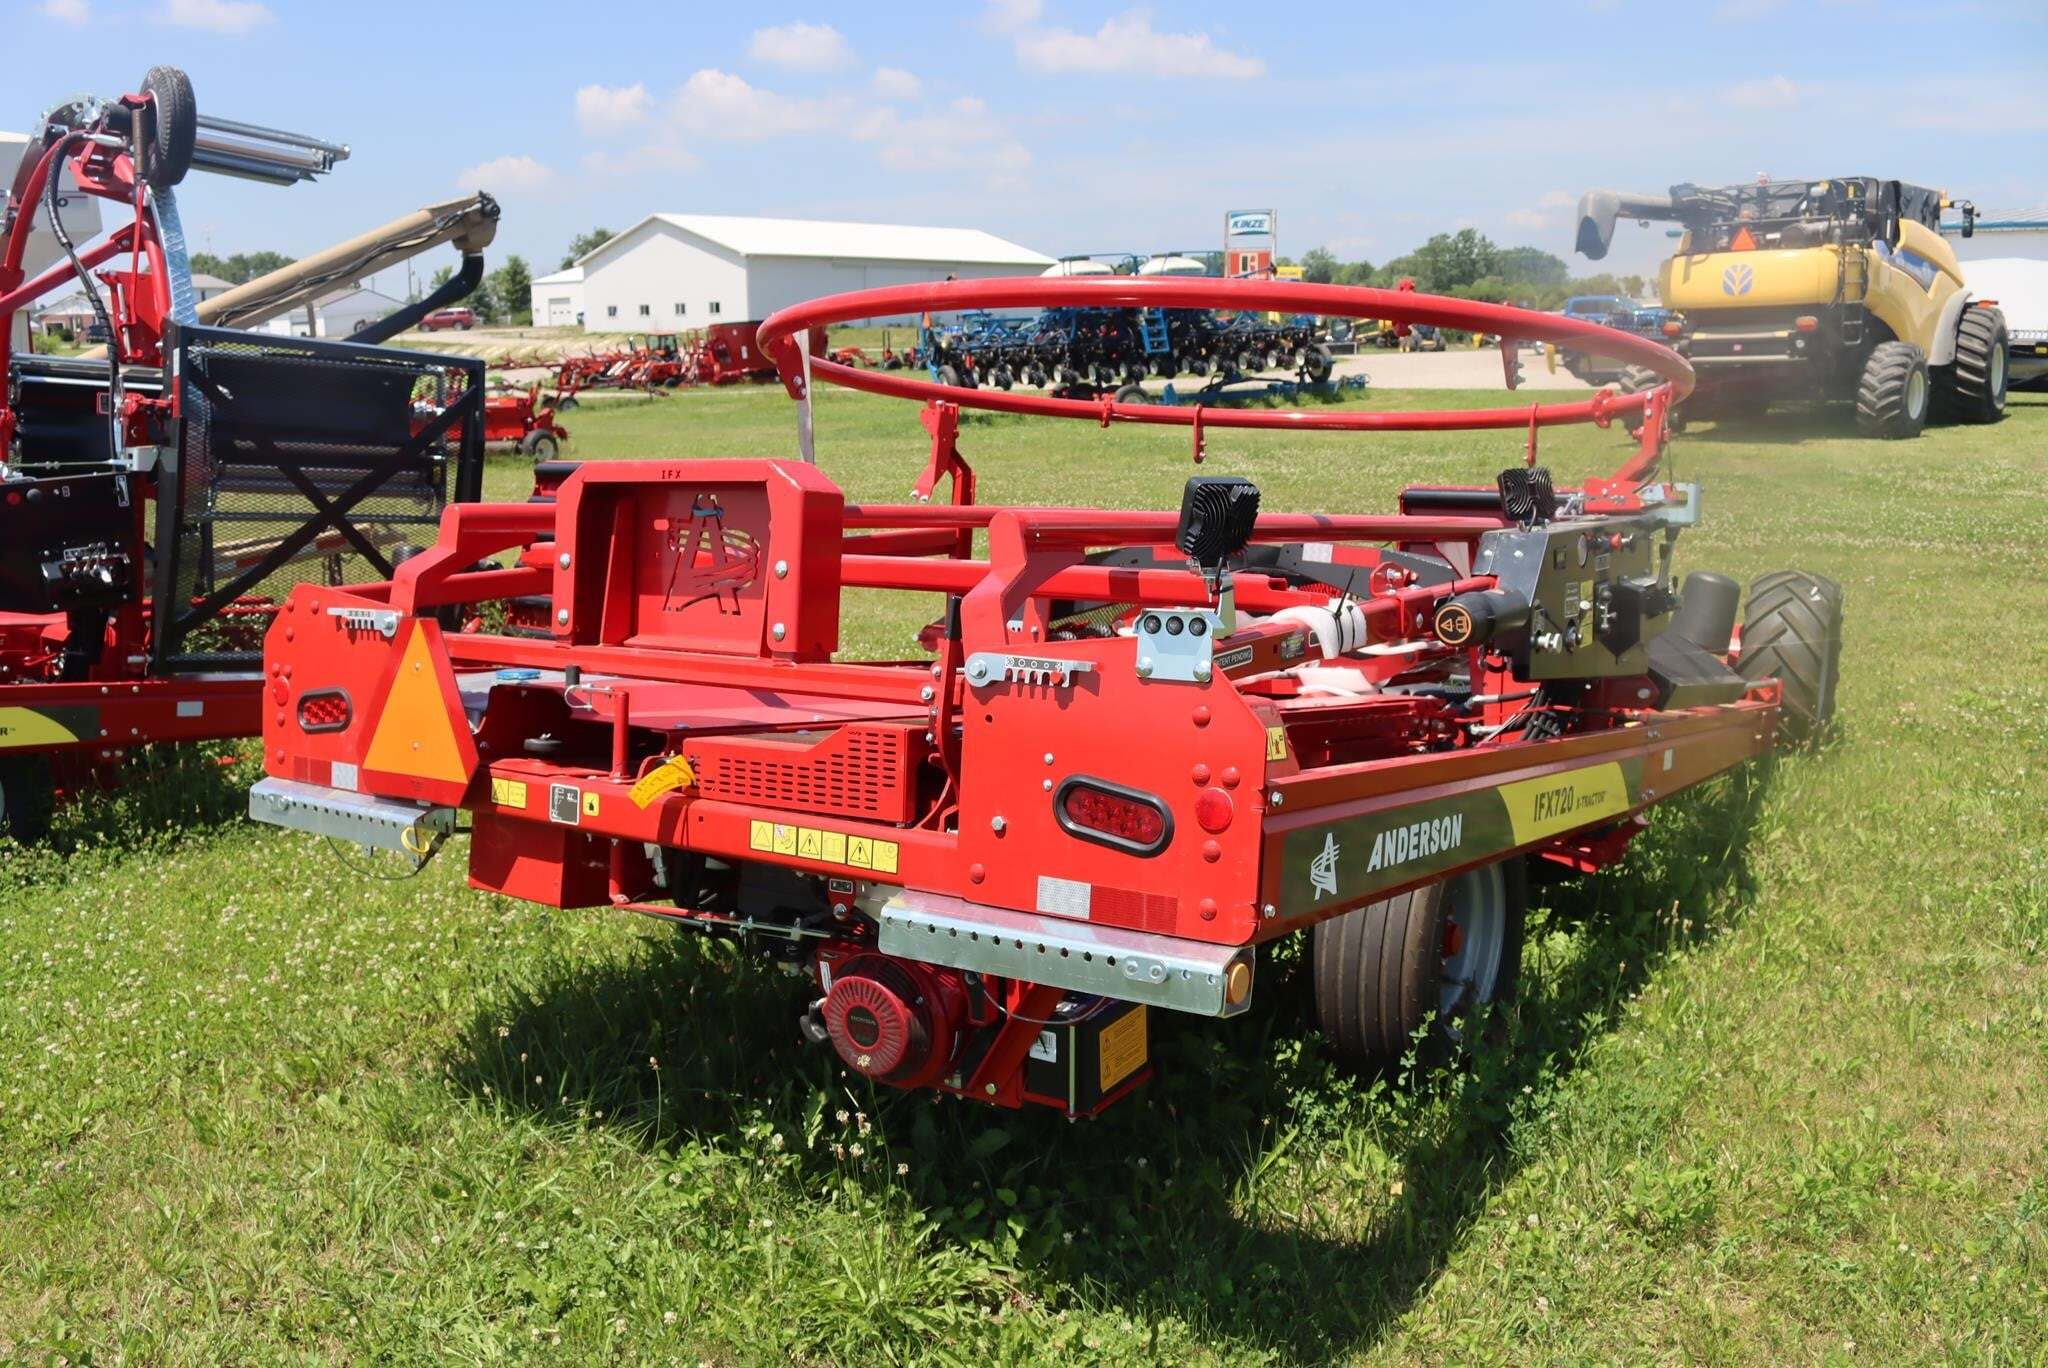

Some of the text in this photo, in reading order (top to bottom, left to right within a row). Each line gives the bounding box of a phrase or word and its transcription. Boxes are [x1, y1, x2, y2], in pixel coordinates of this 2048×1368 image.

[1231, 219, 1266, 229] KINZE
[661, 469, 681, 480] IFX
[1533, 785, 1574, 823] IFX720
[1366, 813, 1463, 873] ANDERSON
